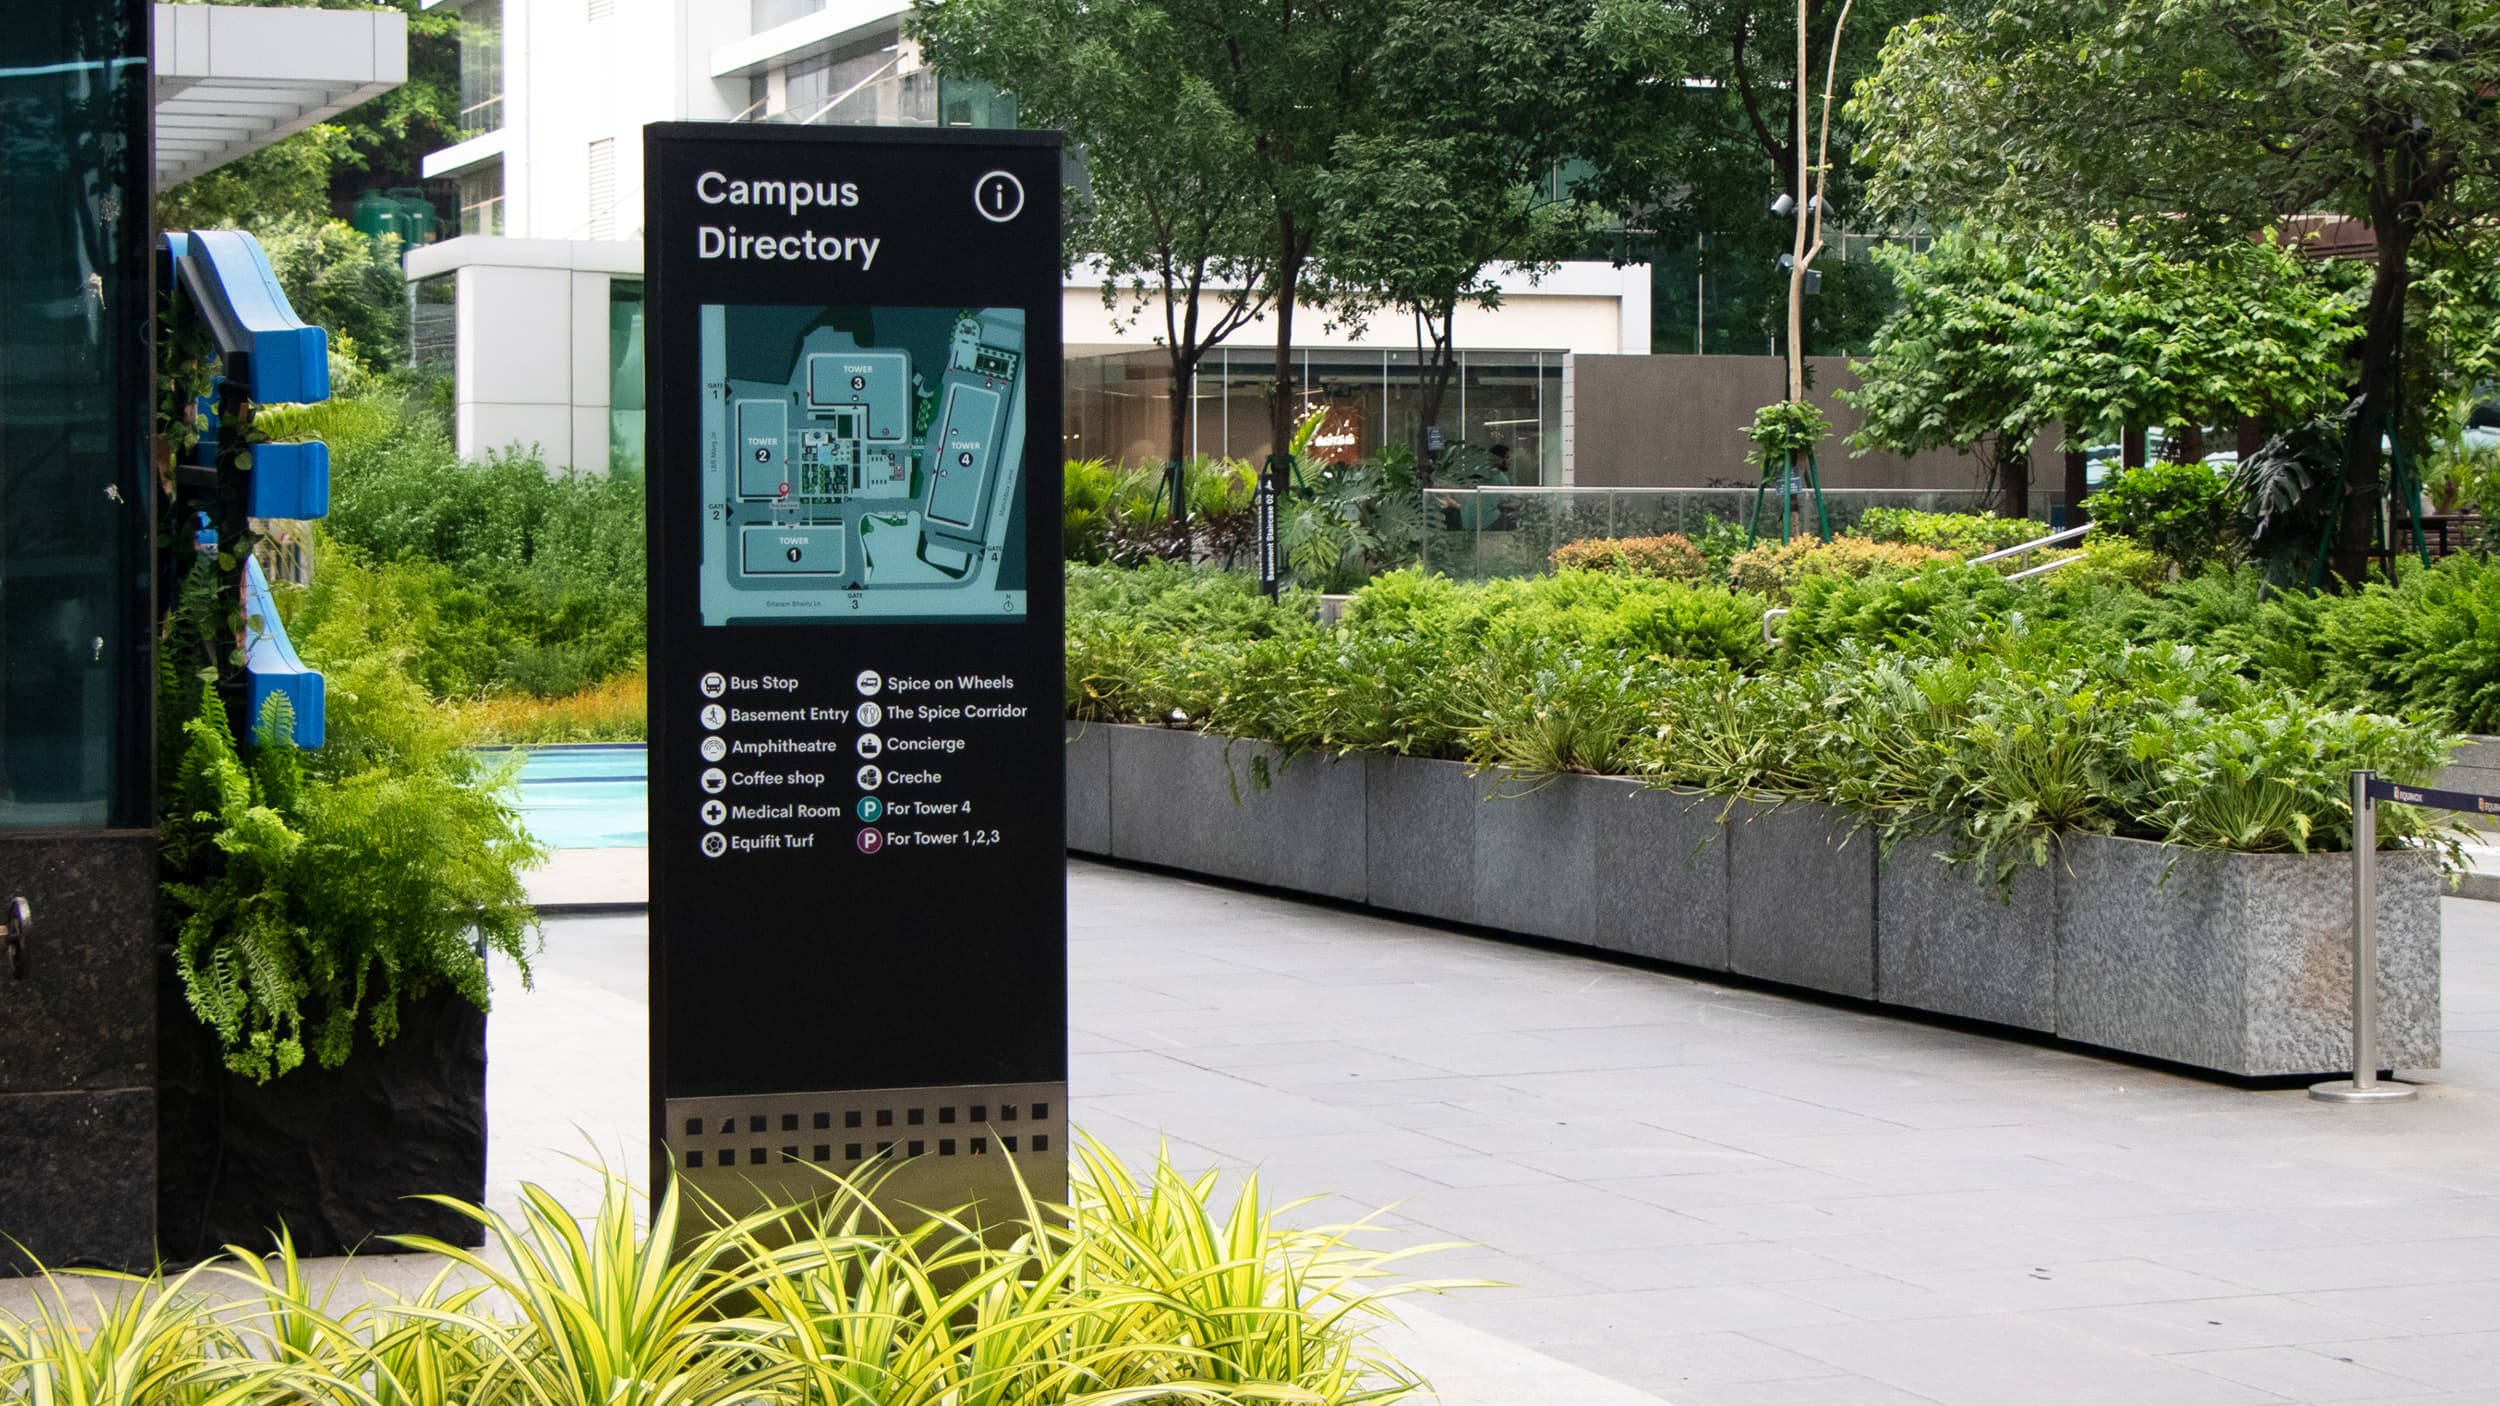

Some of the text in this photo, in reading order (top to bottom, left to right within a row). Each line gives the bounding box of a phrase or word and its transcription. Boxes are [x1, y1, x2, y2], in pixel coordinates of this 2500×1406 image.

[697, 171, 860, 217] Campus
[698, 225, 881, 272] Directory
[844, 365, 873, 374] TOWER
[854, 377, 863, 390] 3
[712, 390, 718, 400] 1
[748, 437, 778, 446] TOWER
[951, 441, 981, 450] TOWER
[758, 449, 768, 462] 2
[961, 454, 971, 465] 4
[712, 510, 721, 521] 2
[779, 537, 810, 545] TOWER
[1265, 494, 1275, 581] Basement Staircase 02
[790, 549, 798, 561] 1
[990, 552, 999, 562] 4
[851, 600, 859, 610] 3
[730, 676, 799, 693] Bus Stop
[887, 675, 1015, 694] Spice on Wheels
[730, 707, 850, 724] Basement Entry
[887, 703, 1028, 723] The Spice Corridor
[731, 738, 838, 757] Amphitheatre
[886, 736, 966, 754] Concierge
[731, 770, 825, 787] Coffee shop
[886, 769, 942, 784] Creche
[731, 804, 841, 819] Medical Room
[887, 802, 911, 815] For
[914, 801, 958, 815] Tower
[961, 800, 972, 814] 4
[731, 833, 815, 852] Equifit Turf
[887, 833, 911, 846] For
[914, 832, 958, 845] Tower
[963, 830, 1001, 846] 1,2,3
